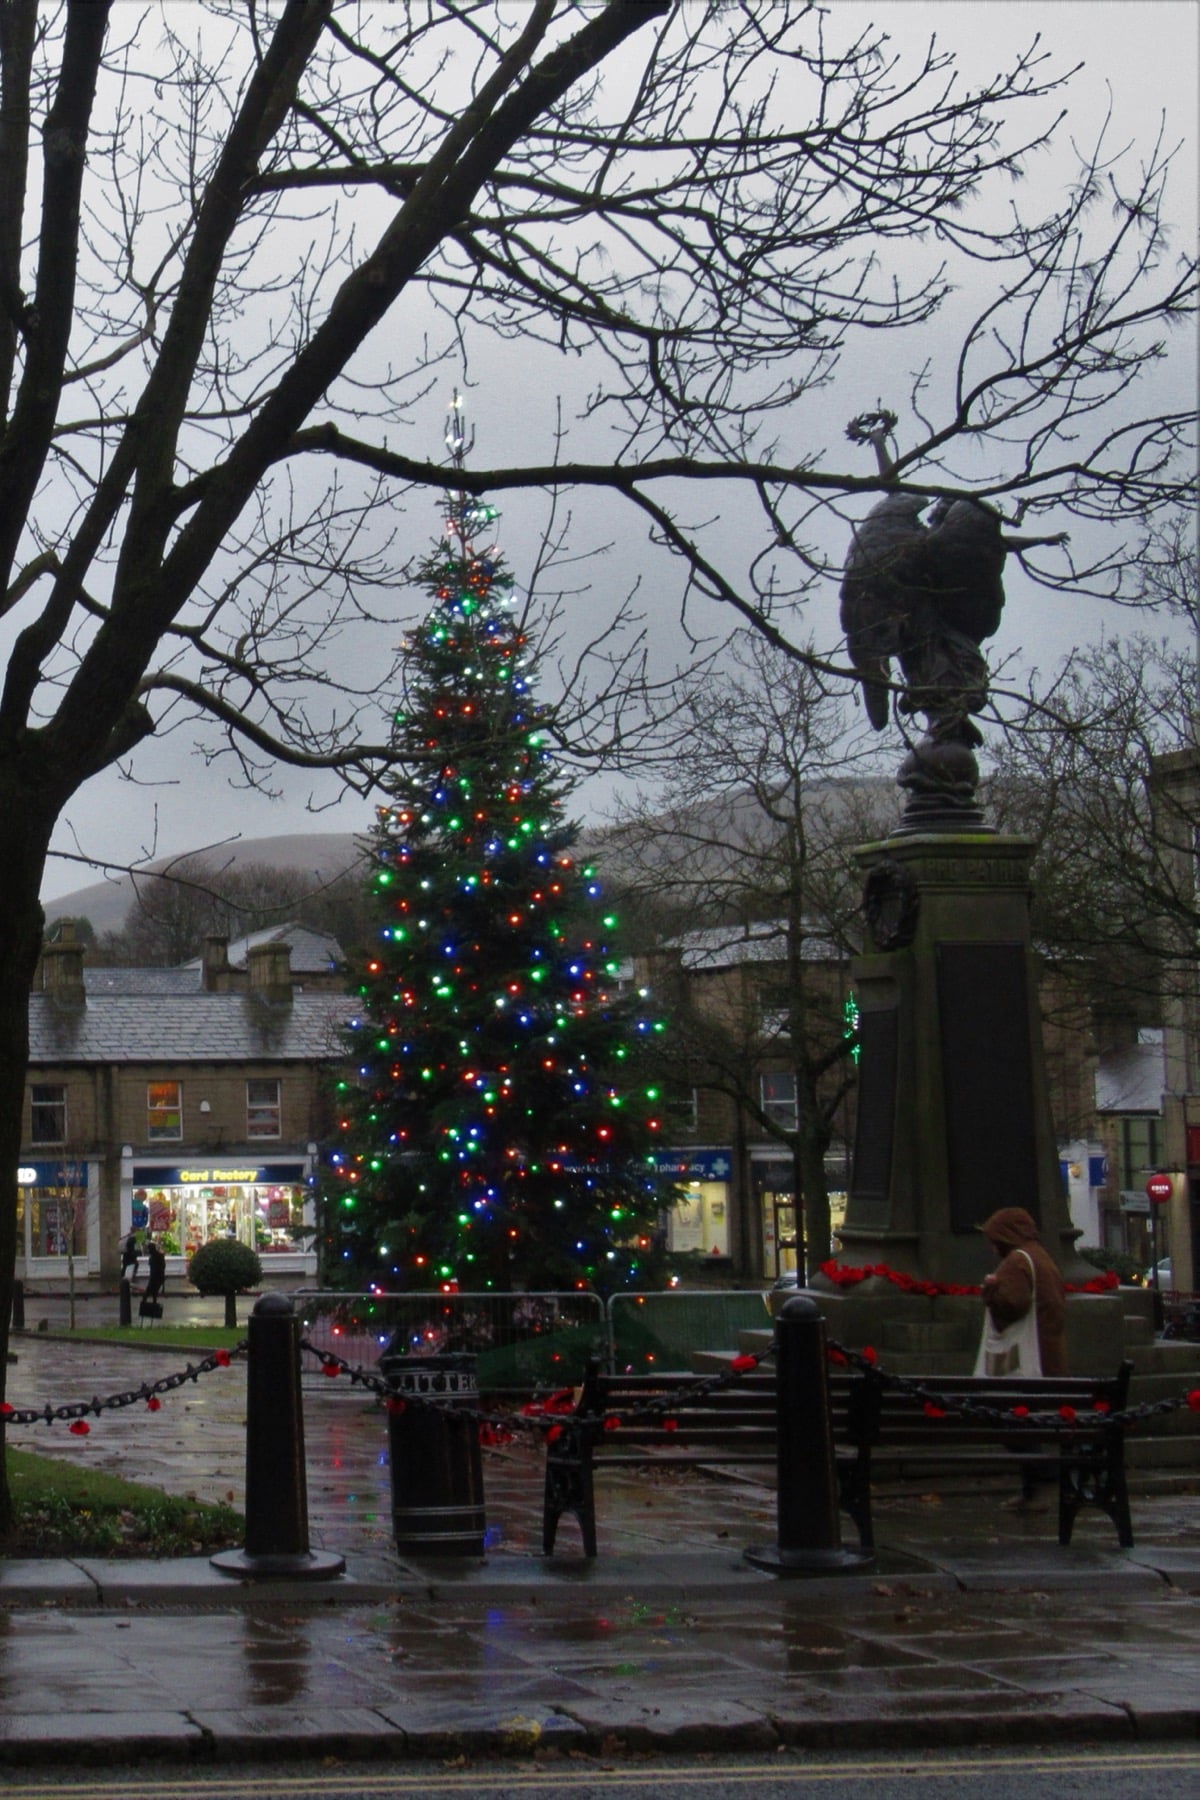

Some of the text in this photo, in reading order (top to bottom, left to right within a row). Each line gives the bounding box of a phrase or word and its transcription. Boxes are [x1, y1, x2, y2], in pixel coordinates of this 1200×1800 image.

[659, 1162, 706, 1173] pharacy
[180, 1169, 258, 1182] Card Factory
[398, 1374, 478, 1393] LITTER
